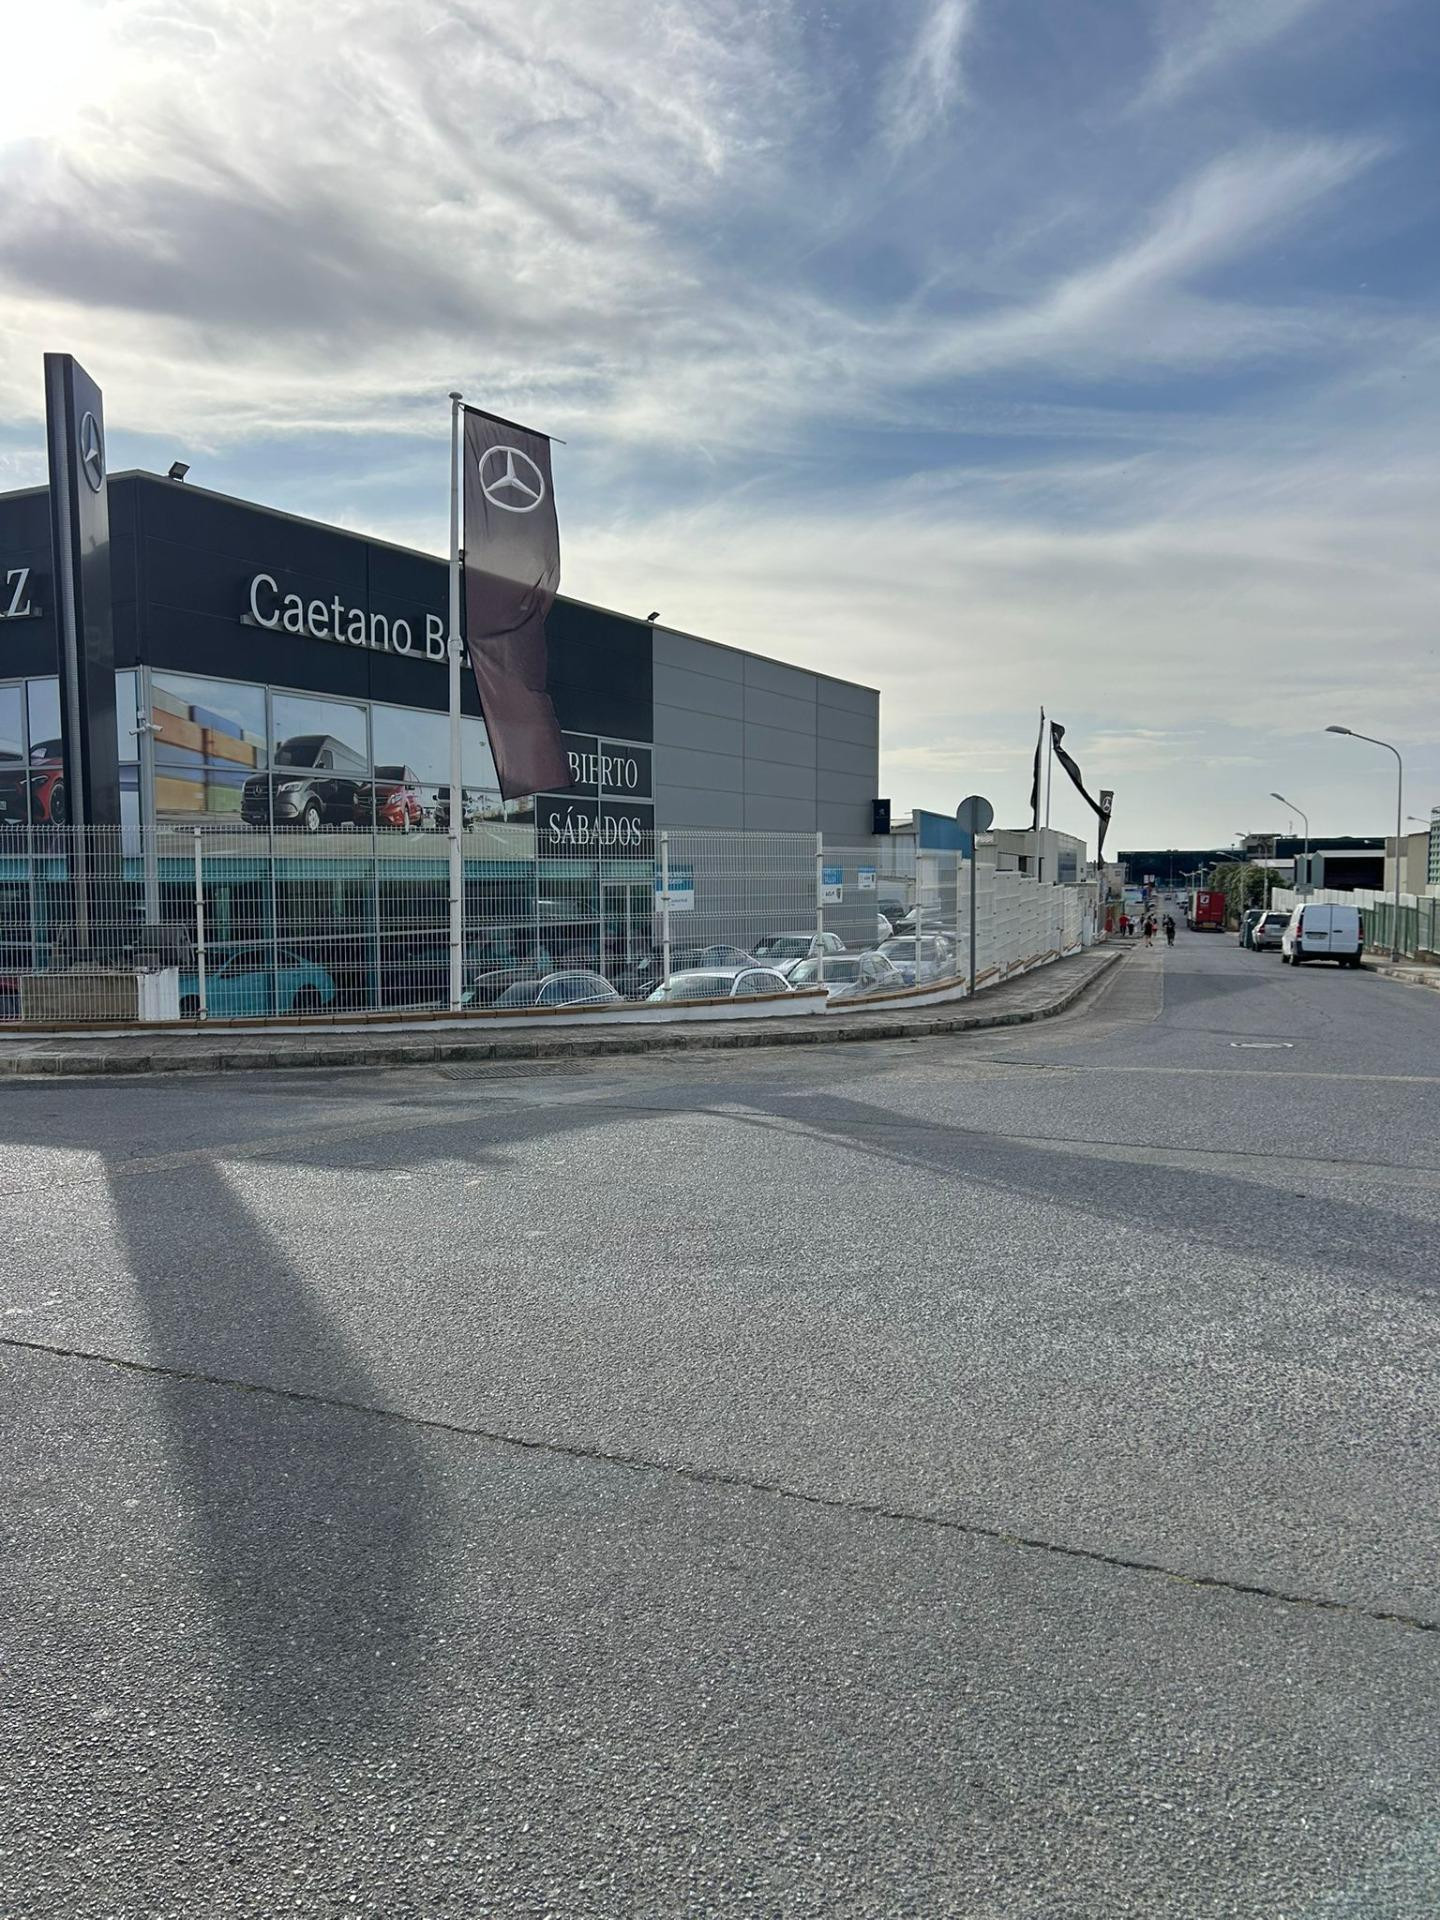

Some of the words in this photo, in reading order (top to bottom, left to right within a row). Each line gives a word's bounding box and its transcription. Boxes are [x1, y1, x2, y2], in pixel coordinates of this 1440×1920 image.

[250, 573, 412, 655] Caetano
[567, 751, 639, 789] BIERTO
[549, 805, 642, 847] SÁBADOS
